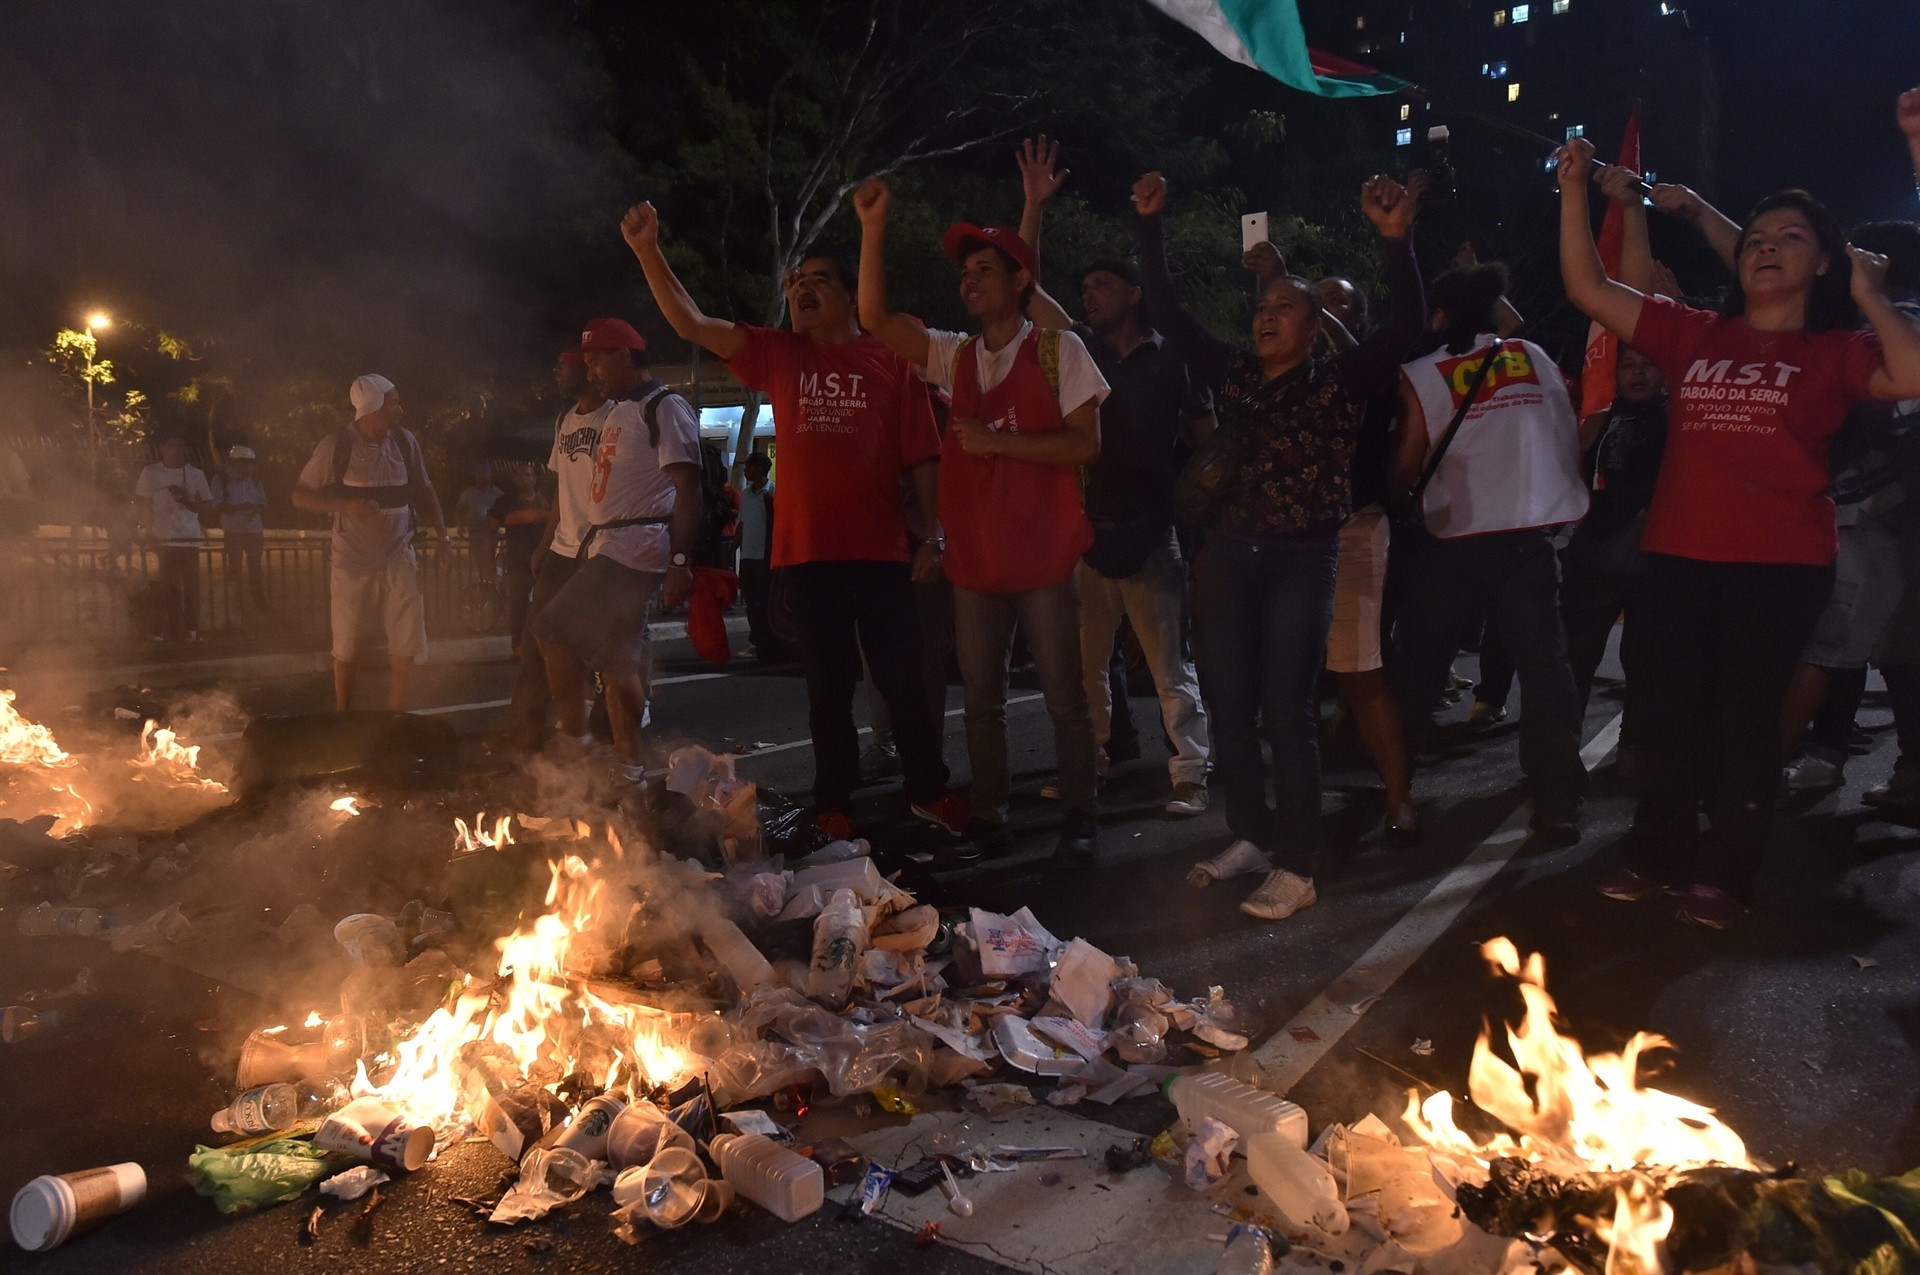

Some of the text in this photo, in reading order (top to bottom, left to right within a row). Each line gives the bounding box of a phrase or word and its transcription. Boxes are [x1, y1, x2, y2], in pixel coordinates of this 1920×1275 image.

[1683, 358, 1801, 388] M.S.T
[799, 370, 866, 398] M.S.T.
[1680, 384, 1789, 406] TABOÃO DA SERRA
[826, 398, 837, 407] DA
[839, 399, 867, 409] SERRA
[1686, 403, 1777, 416] O POVO UNIDO
[828, 408, 855, 417] UNIDO
[1702, 413, 1751, 422] JAMAIS
[807, 415, 841, 424] JAMAIS
[1711, 422, 1777, 435] VENCIDO!
